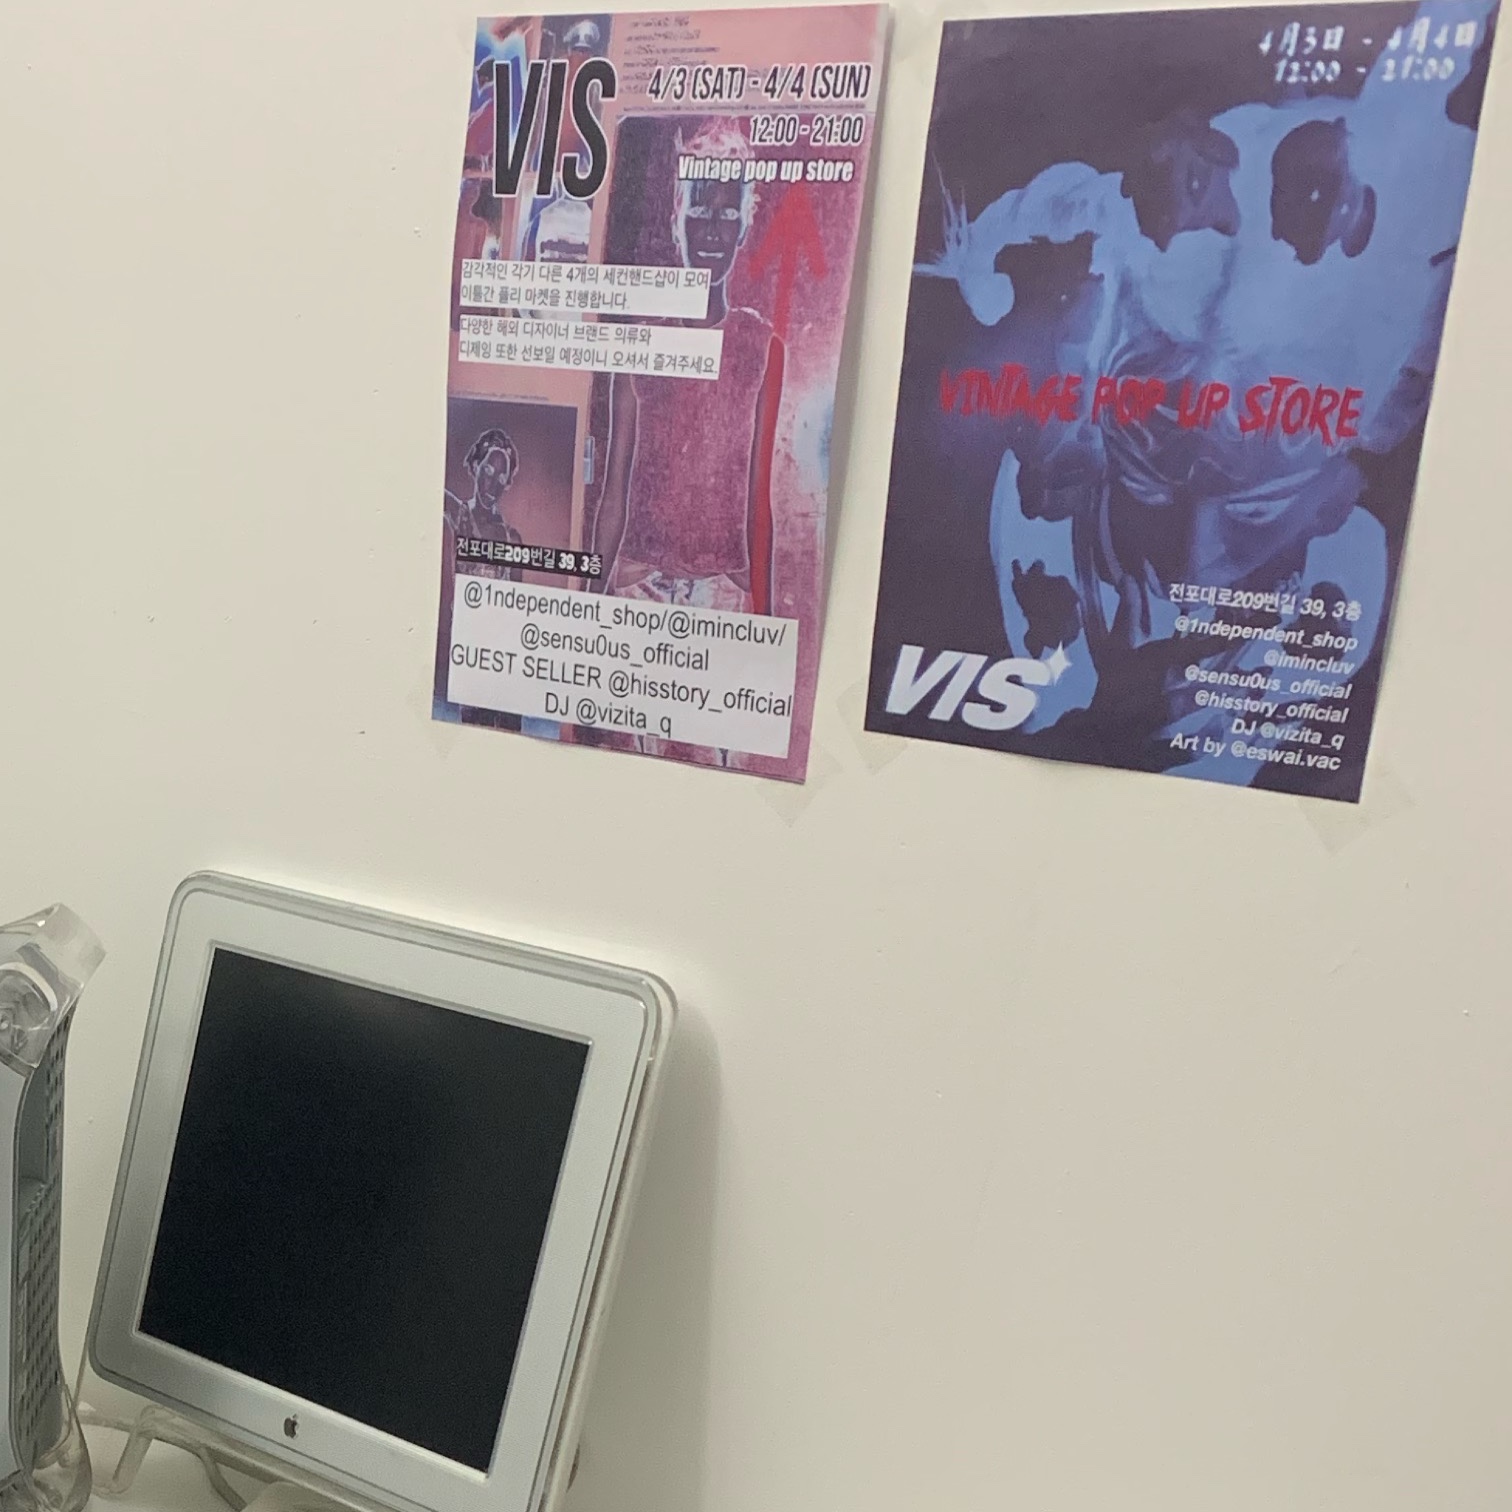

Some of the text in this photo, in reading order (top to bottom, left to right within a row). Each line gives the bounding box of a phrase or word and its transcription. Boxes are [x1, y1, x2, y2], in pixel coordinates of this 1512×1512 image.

[648, 66, 688, 101] 4/3
[691, 65, 747, 101] (SAT)
[764, 64, 806, 100] 4/4
[810, 63, 872, 99] (SUN)
[1274, 58, 1341, 83] 12:00
[493, 57, 618, 200] VIS
[750, 115, 798, 144] 12:00
[811, 115, 864, 144] 21:00
[677, 154, 854, 183] Vintage pop up store
[462, 261, 709, 289] 감각적인 각기 다른 4개의 세컨핸드샵이 모여
[524, 287, 561, 307] 마켓을
[565, 289, 630, 310] 진행합니다.
[459, 318, 652, 346] 다양한 해외 디자이너 브랜드 의류와
[459, 340, 718, 375] 디제잉 또한 선보일 예정이니 오셔서 즐겨주세요.
[940, 362, 1364, 447] VINTAGE POP UP STORE
[456, 536, 602, 576] 전포대로209번길 39, 3층
[463, 580, 787, 647] @1ndependent_shop/@imincluv/
[1169, 582, 1363, 622] 전포대로209번길 39, 3층
[520, 622, 710, 672] @sensu0us_official
[1174, 615, 1359, 653] @1ndependent_shop
[451, 643, 793, 718] GUEST SELLER @hisstory_official
[1263, 649, 1356, 676] @imincluv
[885, 643, 1052, 731] VIS
[1184, 664, 1353, 700] @sensu0us_official
[545, 692, 672, 739] DJ @vizita_q
[1194, 689, 1350, 724] @hisstory_official
[1169, 733, 1342, 771] Art by @eswai.vac
[1231, 718, 1346, 751] DJ @vizita_q
